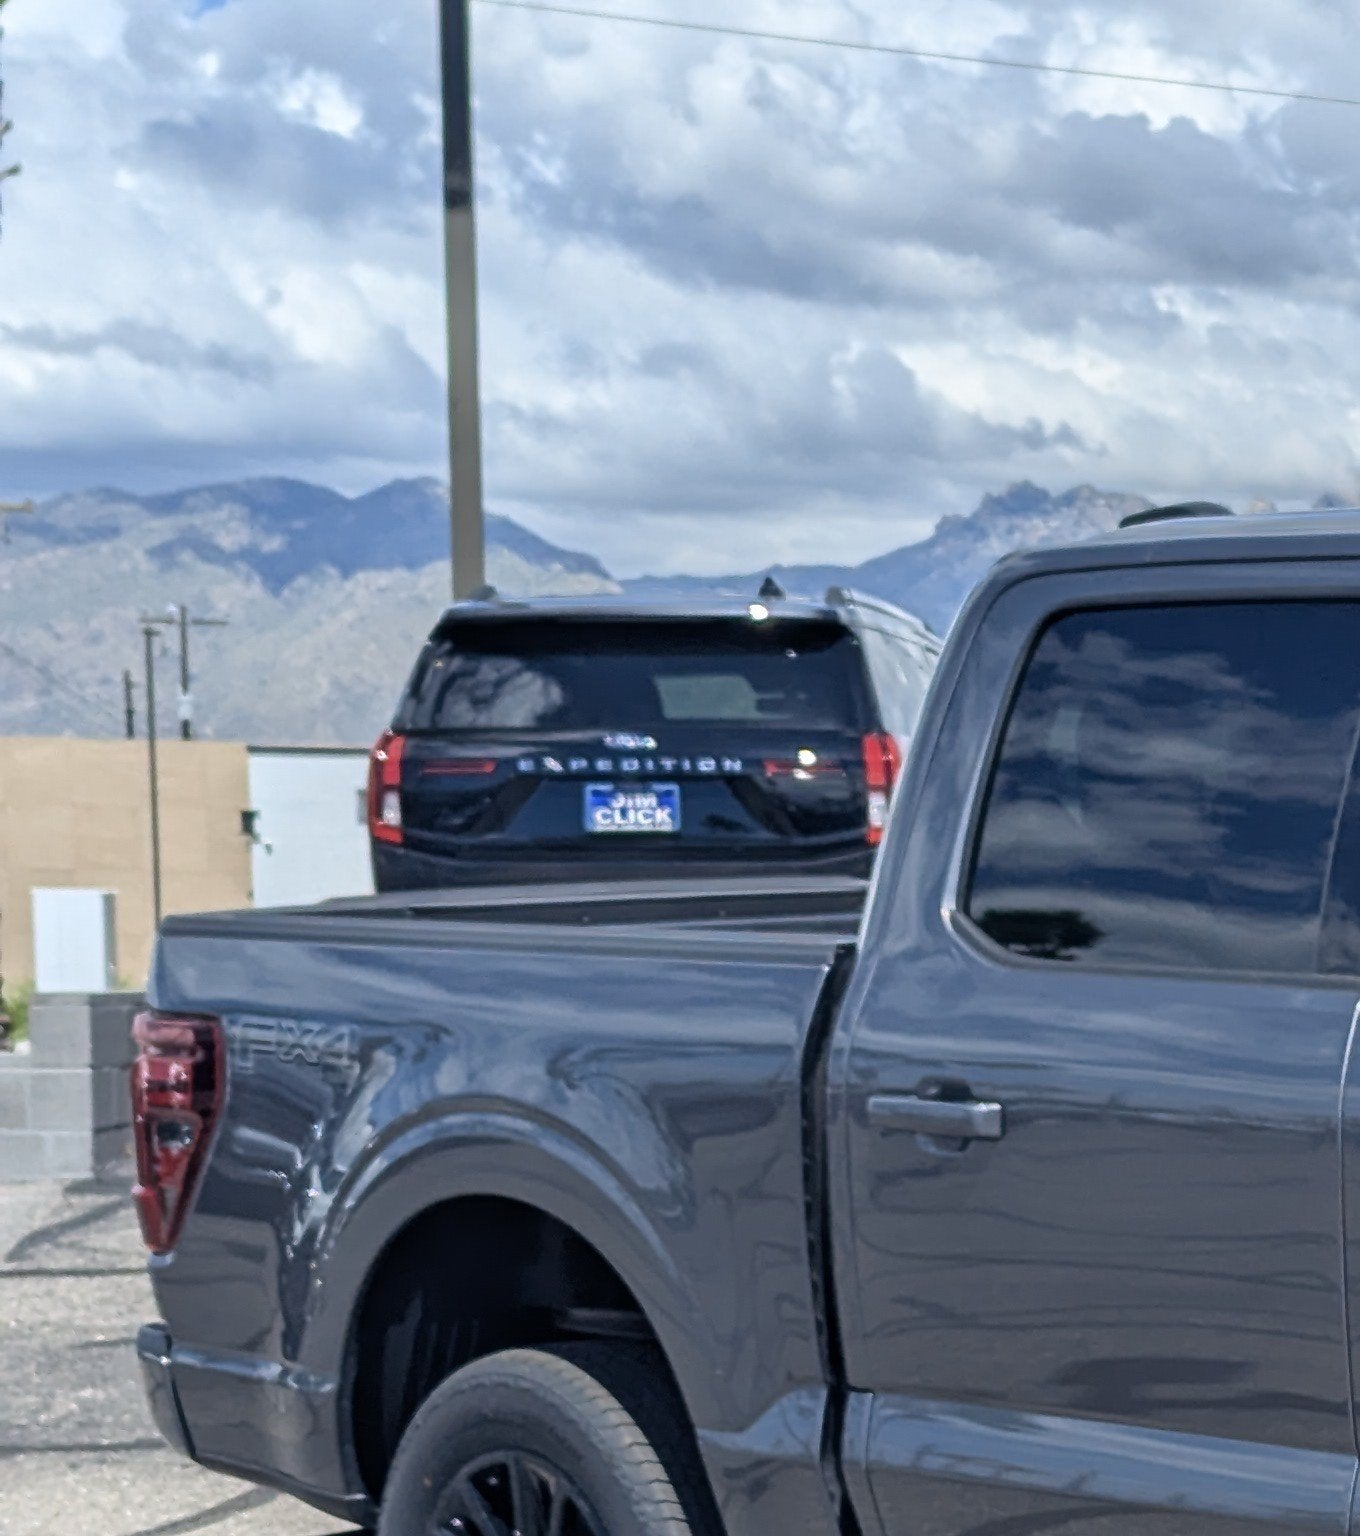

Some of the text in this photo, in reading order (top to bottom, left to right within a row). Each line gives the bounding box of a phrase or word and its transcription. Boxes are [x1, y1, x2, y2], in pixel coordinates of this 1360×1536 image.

[516, 756, 743, 773] EXPEDITION
[609, 793, 658, 809] JIM
[594, 806, 673, 824] CLICK
[230, 1016, 361, 1073] FX4
